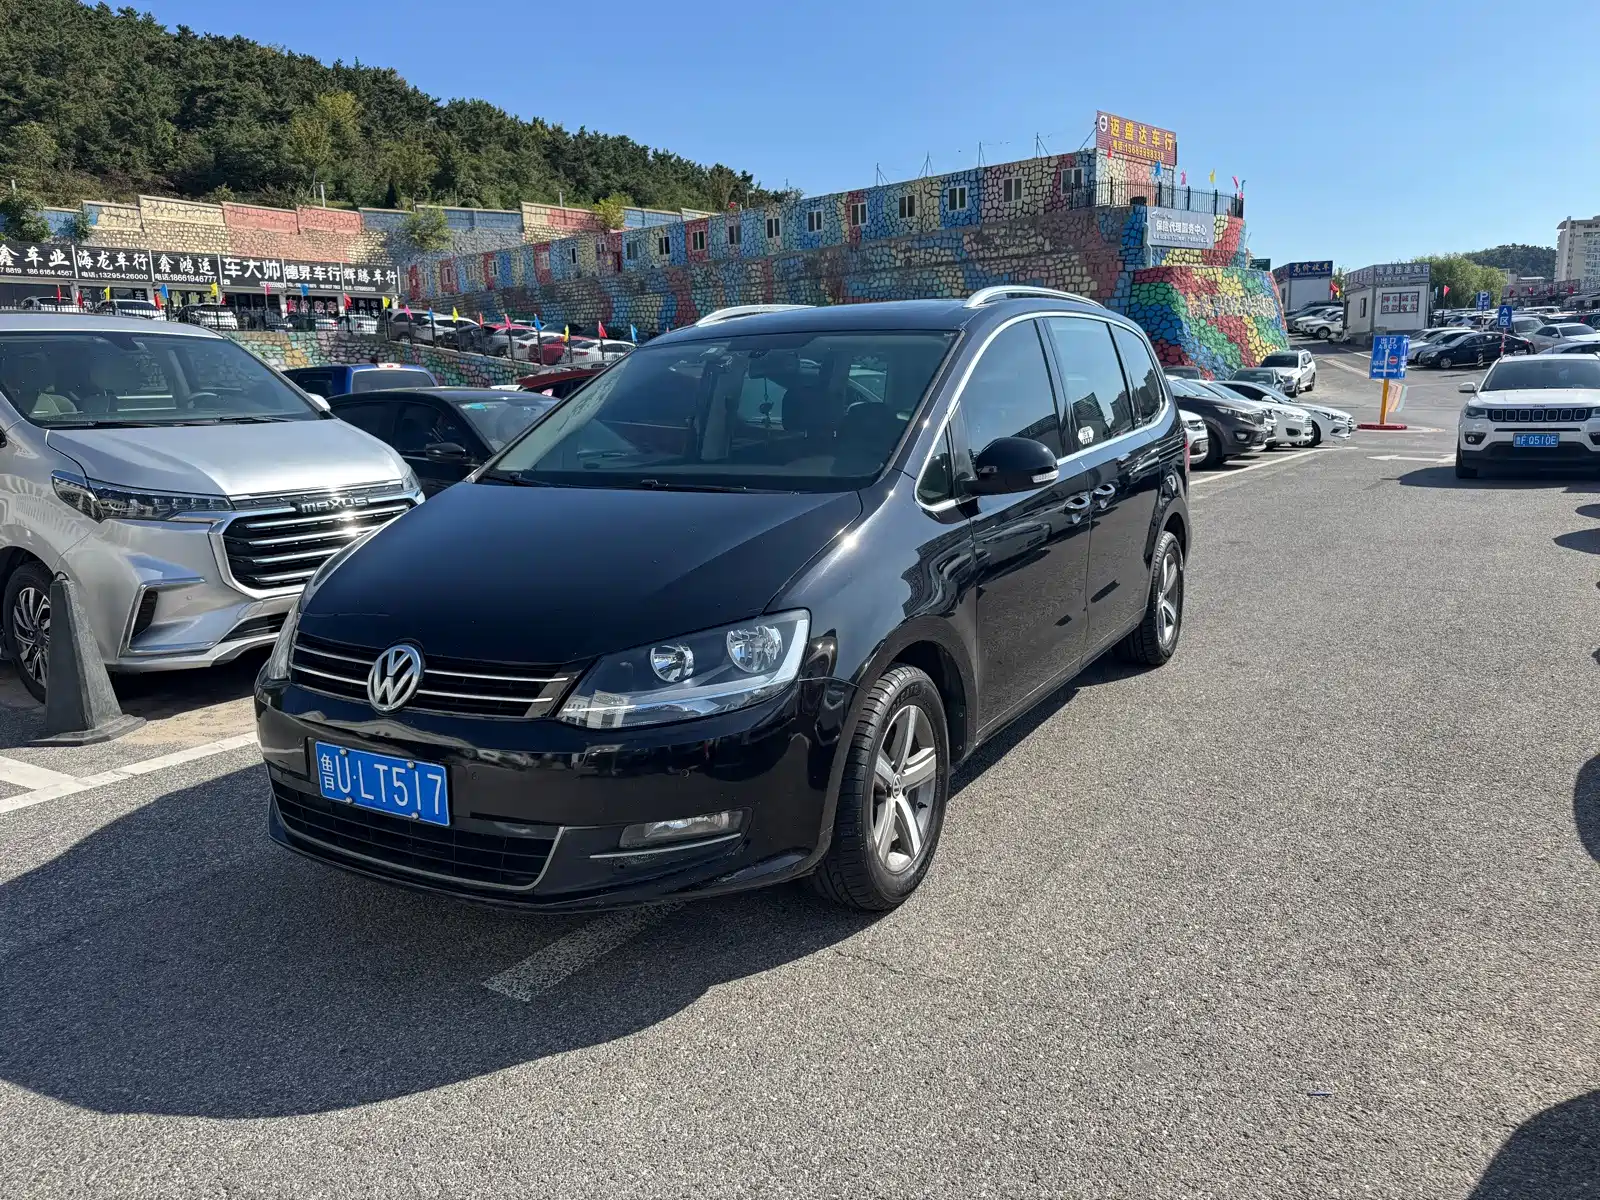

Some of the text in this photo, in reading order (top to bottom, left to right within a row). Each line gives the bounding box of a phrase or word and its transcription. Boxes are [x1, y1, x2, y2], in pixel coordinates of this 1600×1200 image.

[76, 249, 149, 271] 海龙车行
[158, 253, 215, 275] 鑫鸿运
[222, 257, 281, 280] 车大帅
[343, 267, 398, 285] 辉腾车行
[1480, 291, 1489, 301] P
[1502, 307, 1509, 315] A
[1500, 316, 1509, 326] 区
